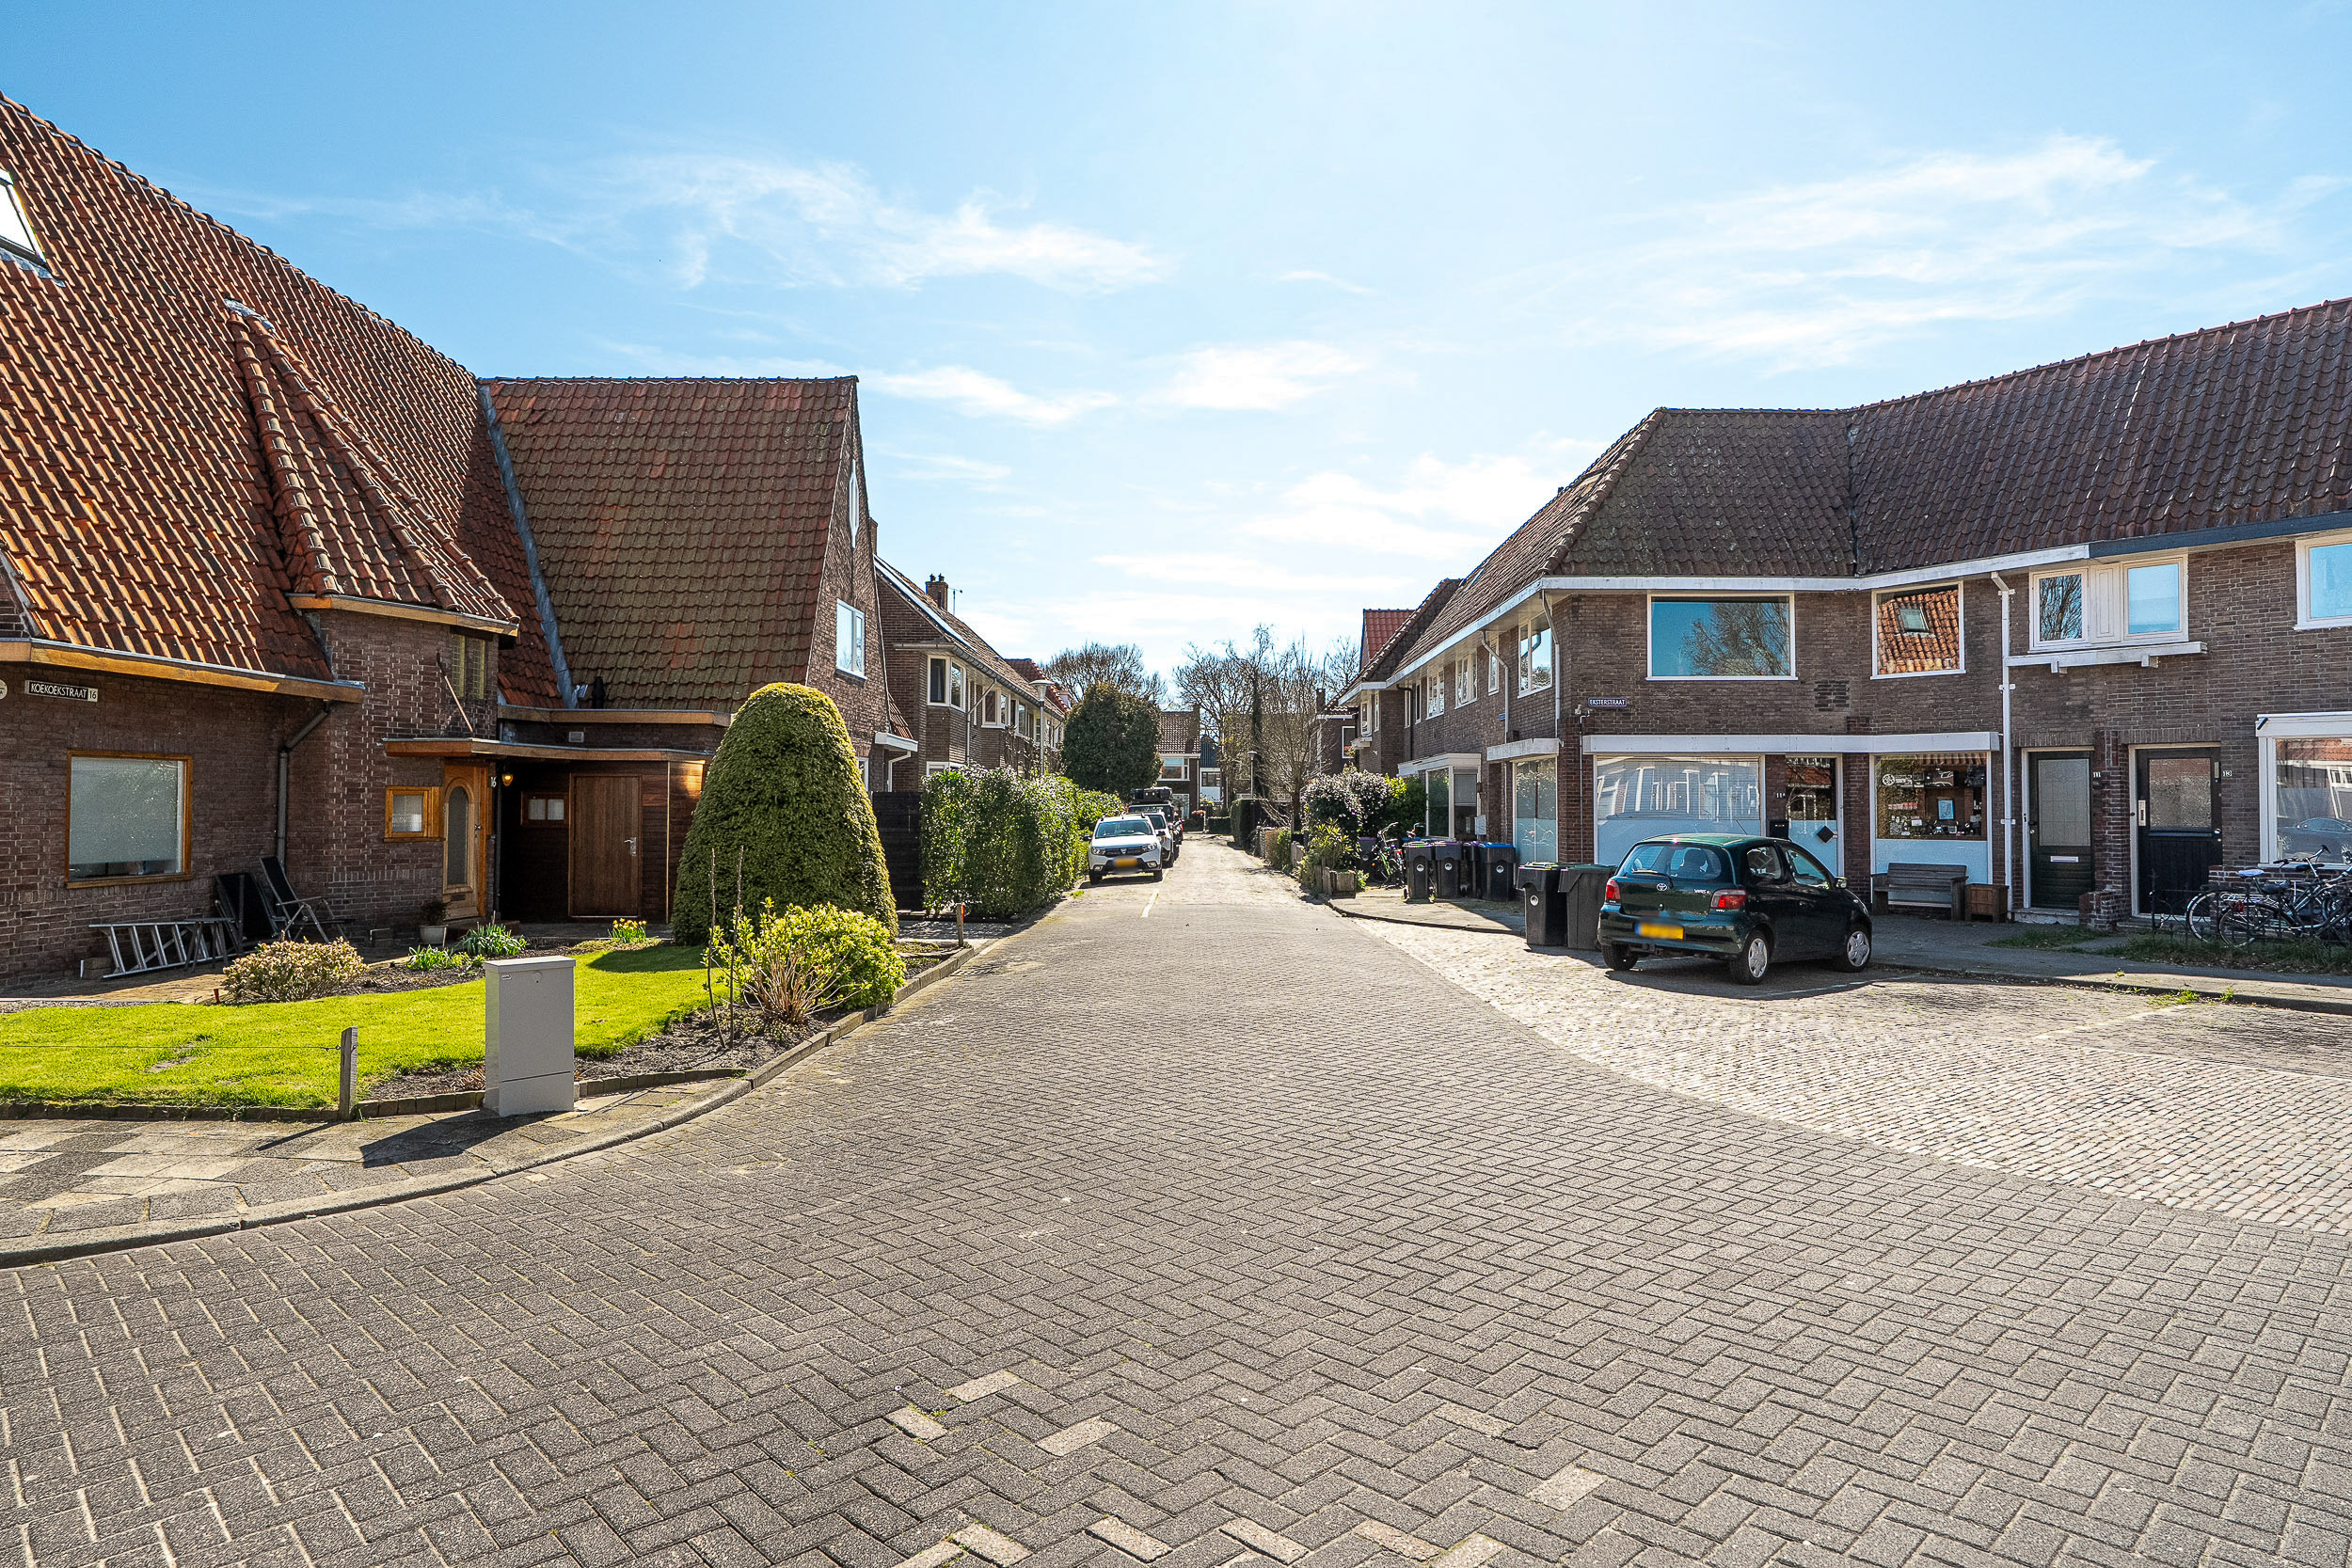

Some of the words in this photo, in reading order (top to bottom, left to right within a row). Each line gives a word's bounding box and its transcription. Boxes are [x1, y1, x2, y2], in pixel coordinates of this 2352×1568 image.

[30, 683, 87, 699] KOEKOEKSTRAAT
[89, 690, 97, 699] 16
[490, 776, 497, 787] 16
